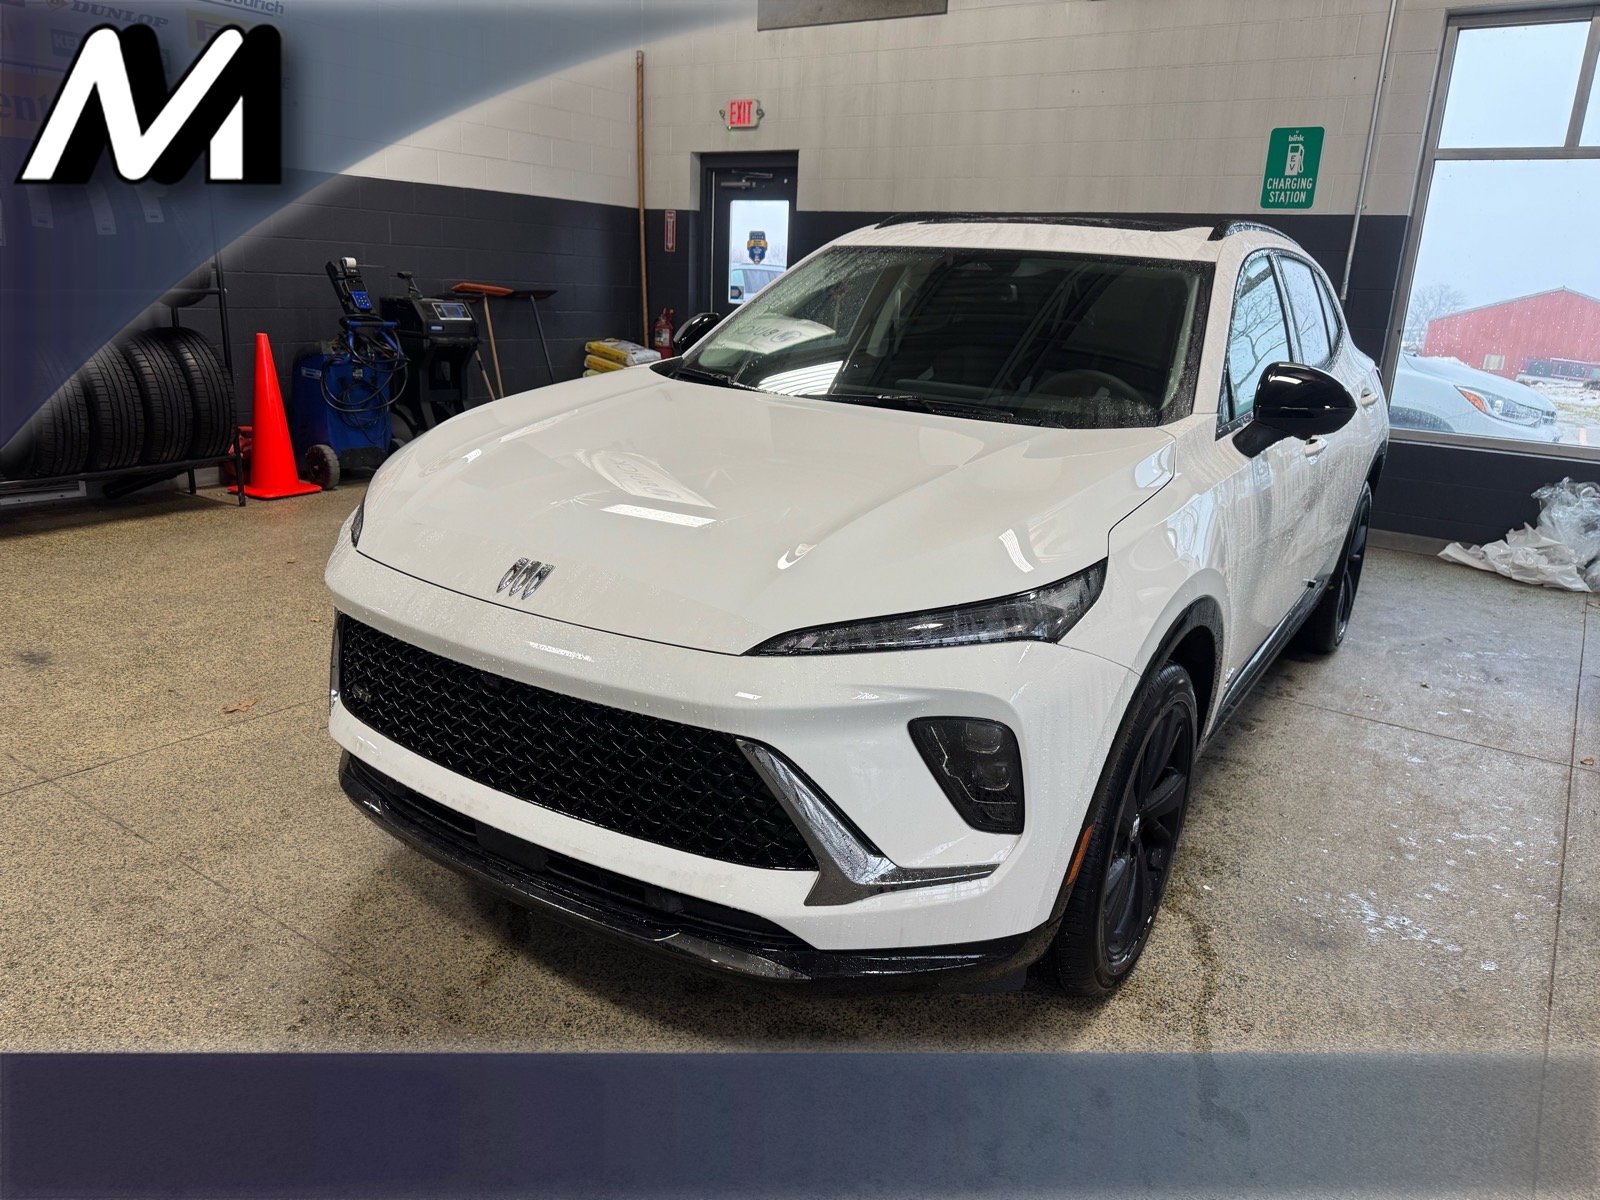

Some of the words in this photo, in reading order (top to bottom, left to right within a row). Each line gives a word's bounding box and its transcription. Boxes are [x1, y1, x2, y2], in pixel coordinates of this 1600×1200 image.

[71, 0, 168, 27] DUNLOP
[730, 101, 752, 125] EXIT
[1266, 178, 1312, 189] CHARGING
[1268, 191, 1306, 203] STATION
